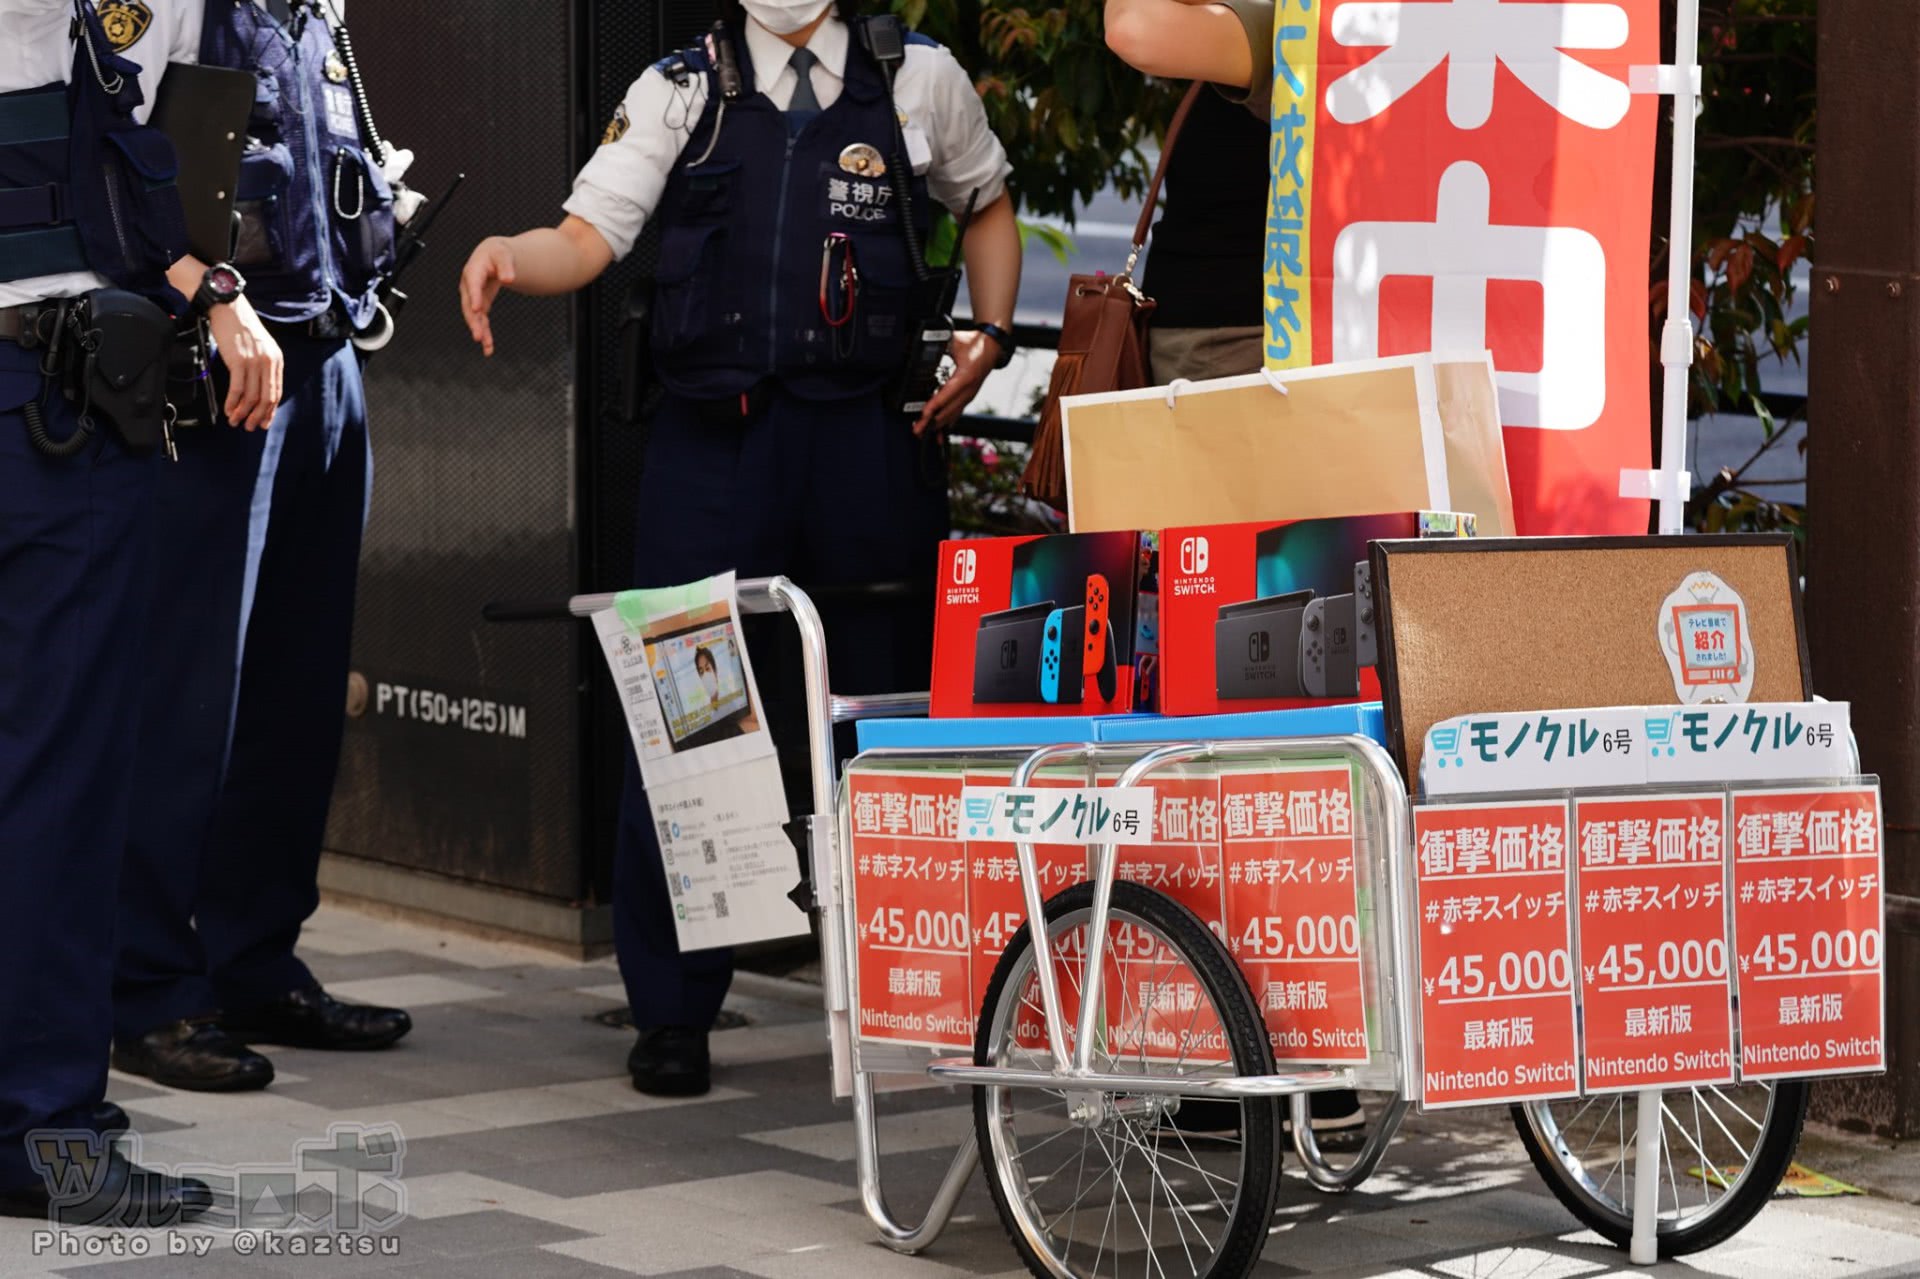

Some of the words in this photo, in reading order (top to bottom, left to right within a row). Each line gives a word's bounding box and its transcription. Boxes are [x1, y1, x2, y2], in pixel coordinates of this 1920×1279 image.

[828, 178, 893, 206] 警視庁
[946, 594, 980, 605] SWITCH
[1174, 584, 1215, 596] SWITCH
[1694, 630, 1725, 650] 紹介
[376, 682, 527, 739] PT(50+125)M
[1471, 716, 1600, 762] モノクル
[1603, 729, 1633, 755] 6号
[1683, 709, 1803, 754] モノクル
[1806, 723, 1835, 748] 6号
[854, 791, 960, 836] 衝撃価格
[1004, 793, 1111, 839] モノクル
[1113, 810, 1141, 835] 6号
[1153, 796, 1218, 841] 価格
[1223, 788, 1350, 837] 衝撃価格
[1581, 816, 1721, 865] 衝撃価格
[1737, 808, 1877, 857] 衝撃価格
[1420, 824, 1564, 875] 衝撃価格
[859, 853, 965, 882] #赤字スイッチ
[973, 857, 1086, 886] #赤字イッチ
[1119, 861, 1220, 888] 赤字スイッチ
[1229, 857, 1352, 885] #赤字スイッチ
[1585, 882, 1722, 913] #赤字スイッチ
[1740, 873, 1878, 903] #赤字スイッチ
[1425, 891, 1565, 923] #赤字スイッチ
[860, 907, 969, 952] ¥45,000
[1231, 915, 1359, 961] ¥45,000
[1584, 938, 1728, 989] ¥45,000
[1739, 928, 1881, 977] ¥45,000
[888, 967, 942, 997] 最新版
[1424, 949, 1571, 1001] ¥45,000
[1138, 981, 1196, 1011] 最新版
[1266, 980, 1328, 1010] 最新版
[1778, 993, 1843, 1026] 最新版
[862, 1008, 922, 1031] Nintendo
[926, 1013, 972, 1036] Switch
[1464, 1016, 1534, 1050] 最新版
[1625, 1005, 1692, 1037] 最新版
[1109, 1026, 1176, 1050] Nintendo
[1312, 1028, 1366, 1048] Switch
[1744, 1041, 1820, 1064] Nintendo
[1825, 1035, 1881, 1059] Switch
[1426, 1067, 1509, 1092] Nintendo
[1514, 1060, 1575, 1085] Switch
[1588, 1053, 1668, 1078] Nintendo
[1673, 1048, 1731, 1072] Switch
